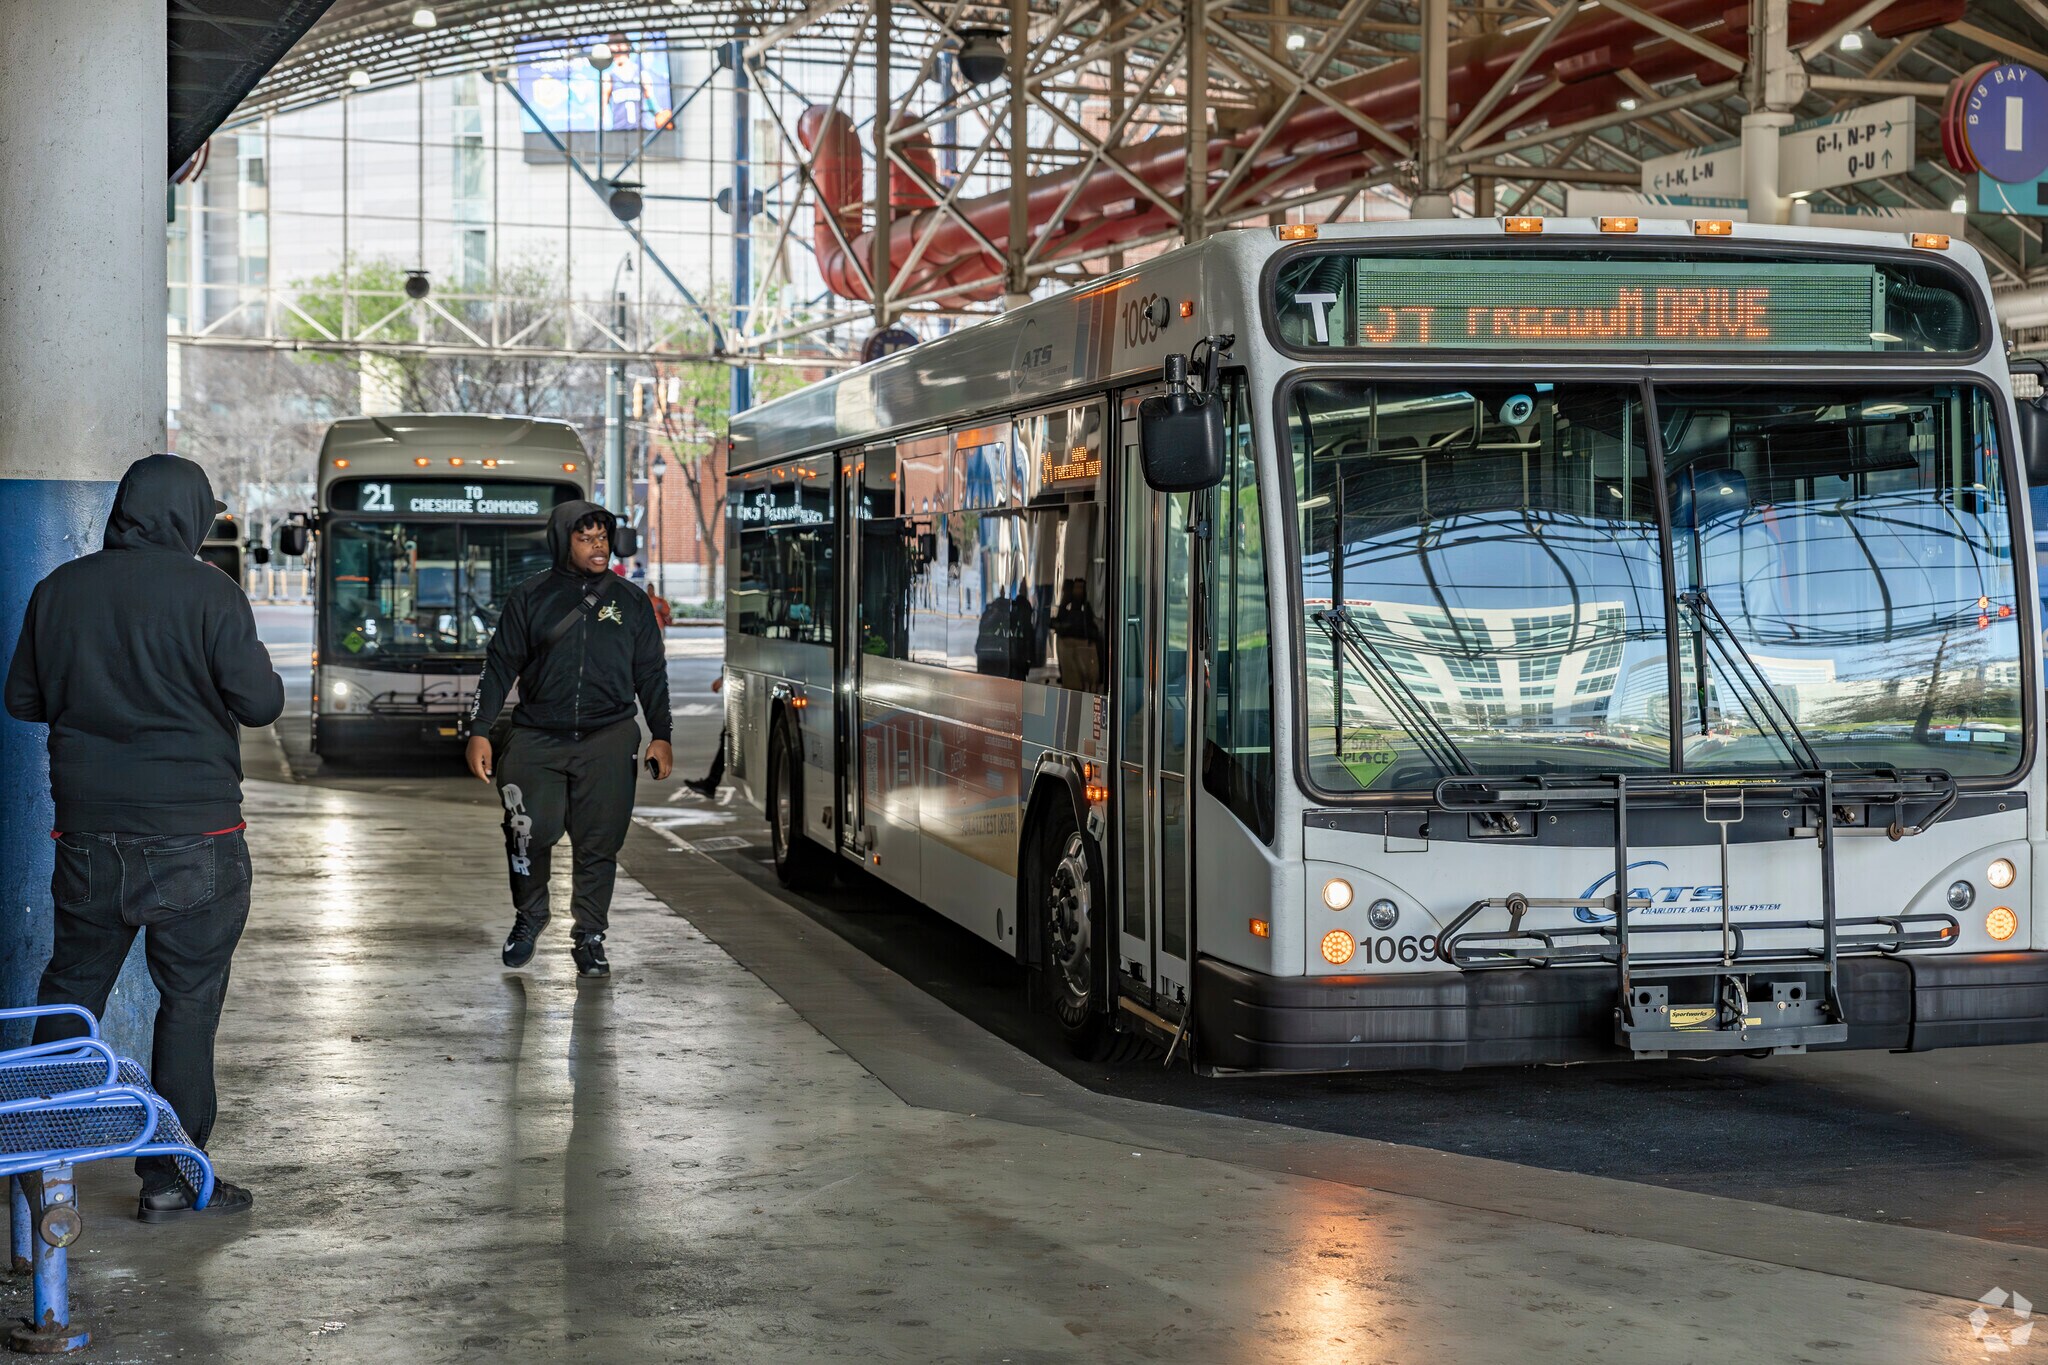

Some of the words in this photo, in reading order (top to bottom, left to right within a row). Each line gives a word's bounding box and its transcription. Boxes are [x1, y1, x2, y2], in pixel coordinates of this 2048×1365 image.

[1969, 84, 1988, 124] BUS
[1994, 68, 2027, 84] BAY
[1816, 131, 1842, 155] G-I,
[1848, 124, 1876, 147] N-P
[1666, 169, 1688, 188] I-K,
[1692, 162, 1714, 180] L-N
[1848, 151, 1875, 178] Q-U
[1656, 287, 1770, 337] DRIVE
[363, 484, 394, 512] 21
[464, 486, 483, 500] TO
[410, 499, 474, 513] CHESHIRE
[477, 500, 539, 515] COMMONS
[1640, 906, 1686, 915] CHARLOTTE
[1689, 905, 1710, 914] AREA
[1713, 904, 1748, 912] TRNSIT
[1748, 903, 1782, 911] SYSTEM
[1359, 934, 1438, 964] 1069
